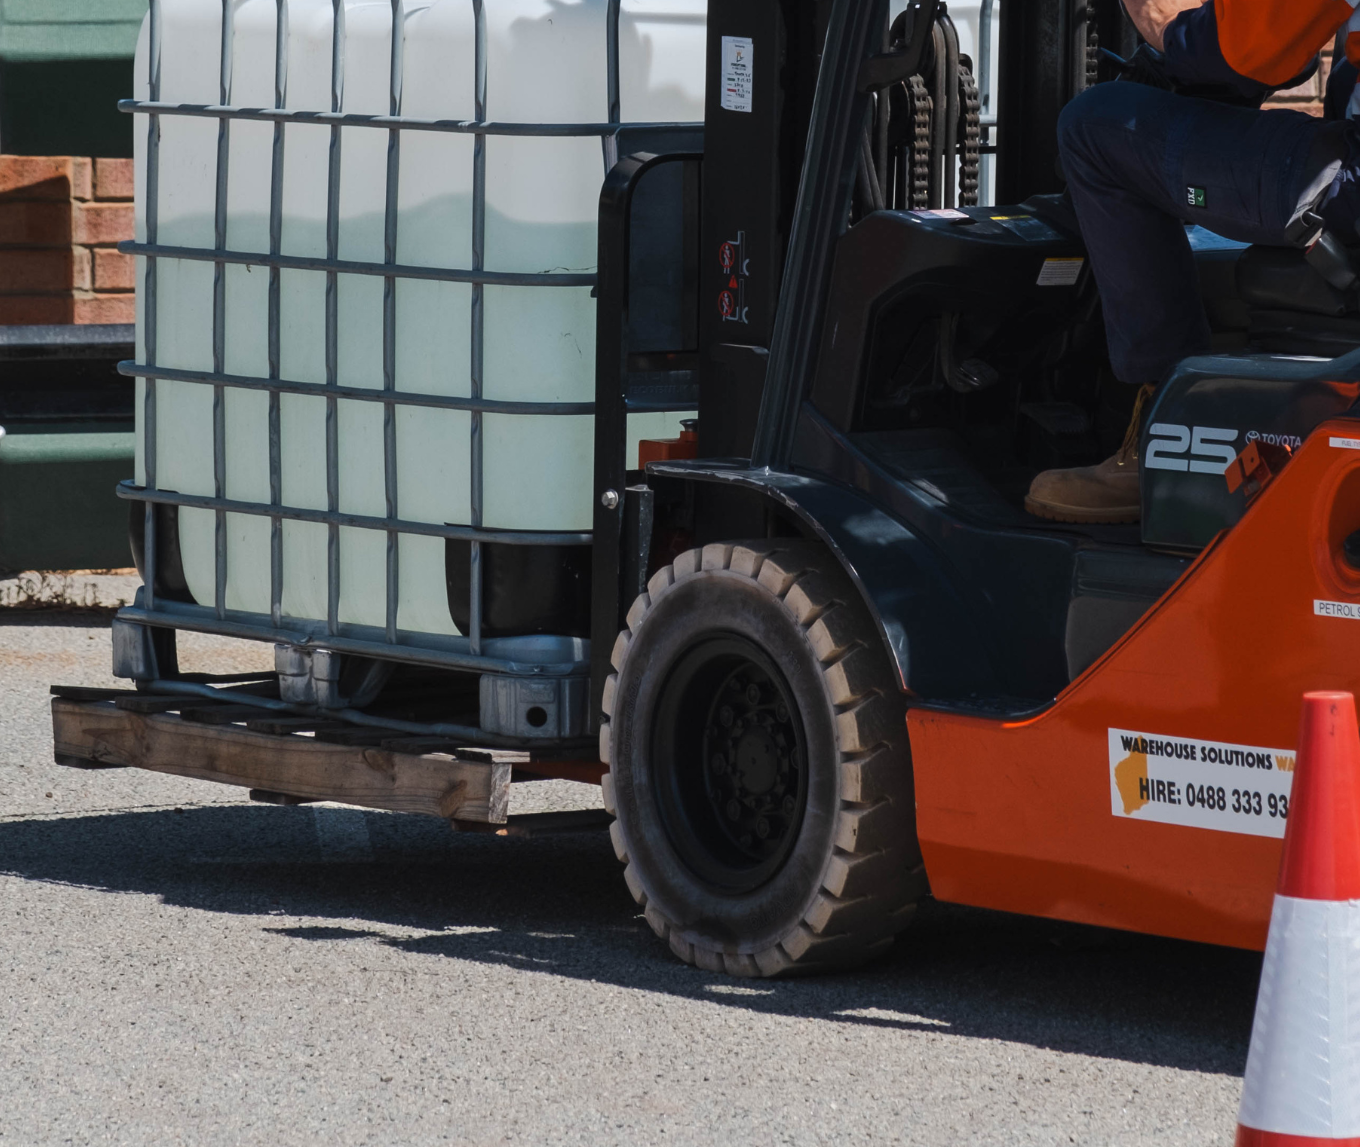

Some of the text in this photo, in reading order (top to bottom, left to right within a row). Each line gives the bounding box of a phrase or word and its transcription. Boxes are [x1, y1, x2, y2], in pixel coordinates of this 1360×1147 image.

[1187, 187, 1196, 205] FXD
[1144, 422, 1239, 475] 25
[1261, 432, 1302, 448] TOYOTA
[1319, 602, 1355, 617] PETROL
[1120, 735, 1196, 761] WAREHOUSE
[1200, 746, 1273, 770] SOLUTIONS
[1139, 777, 1182, 805] HIRE:
[1186, 782, 1227, 812] 0488
[1231, 789, 1263, 816] 333
